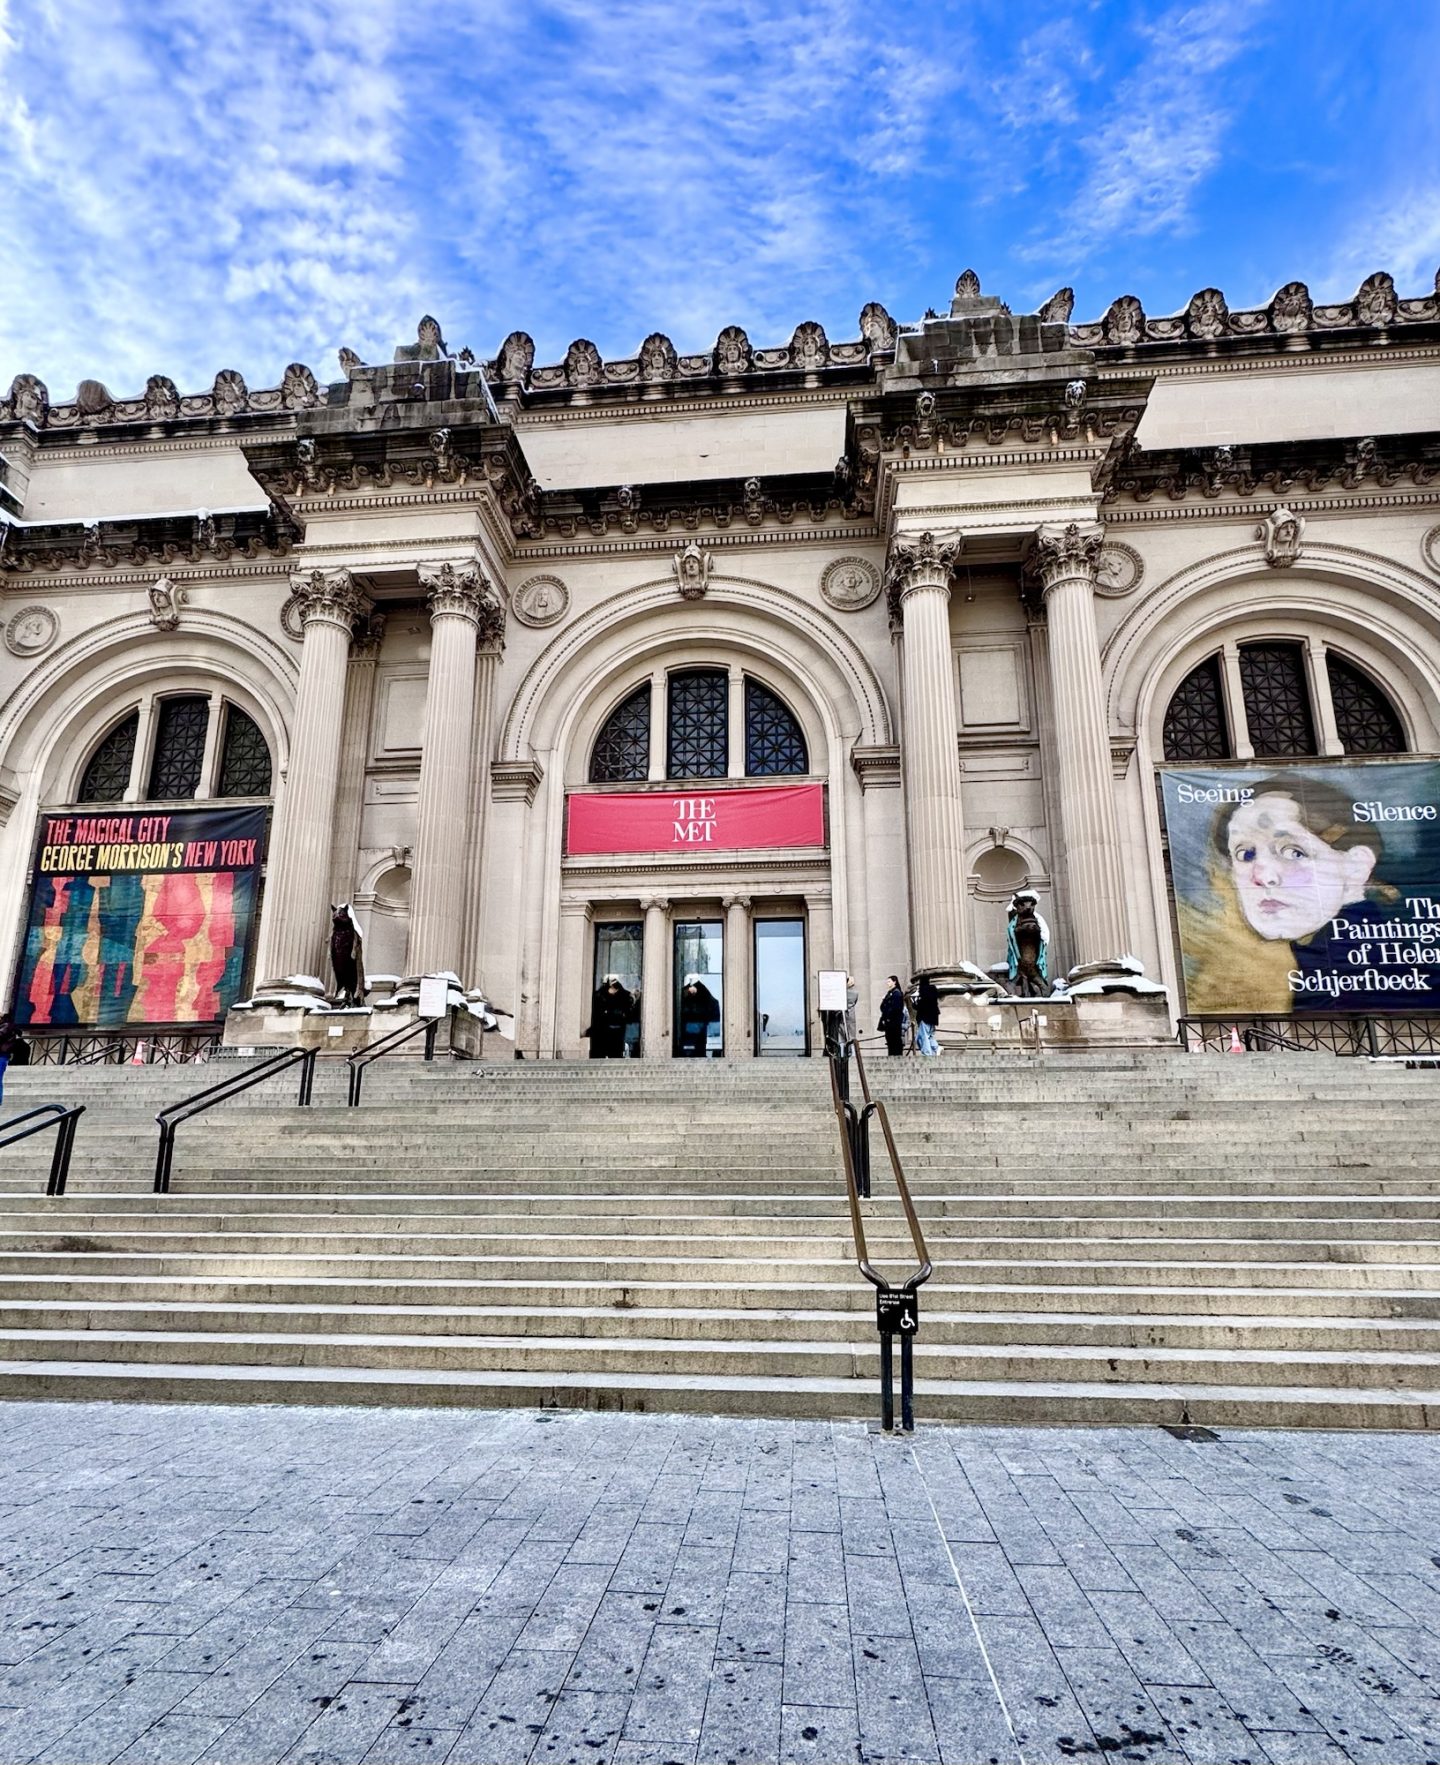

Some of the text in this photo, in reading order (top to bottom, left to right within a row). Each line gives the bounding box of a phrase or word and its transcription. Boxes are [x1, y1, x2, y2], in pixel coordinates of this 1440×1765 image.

[1177, 784, 1255, 807] Seeing
[673, 798, 717, 820] THE
[1353, 801, 1437, 822] Silence
[46, 816, 171, 845] THE MAGICAL CITY
[672, 821, 717, 843] MET
[40, 839, 257, 872] GEORGE MORRISON'S NEW YORK
[1347, 943, 1373, 965] of
[1288, 968, 1432, 997] Schjerfbeck
